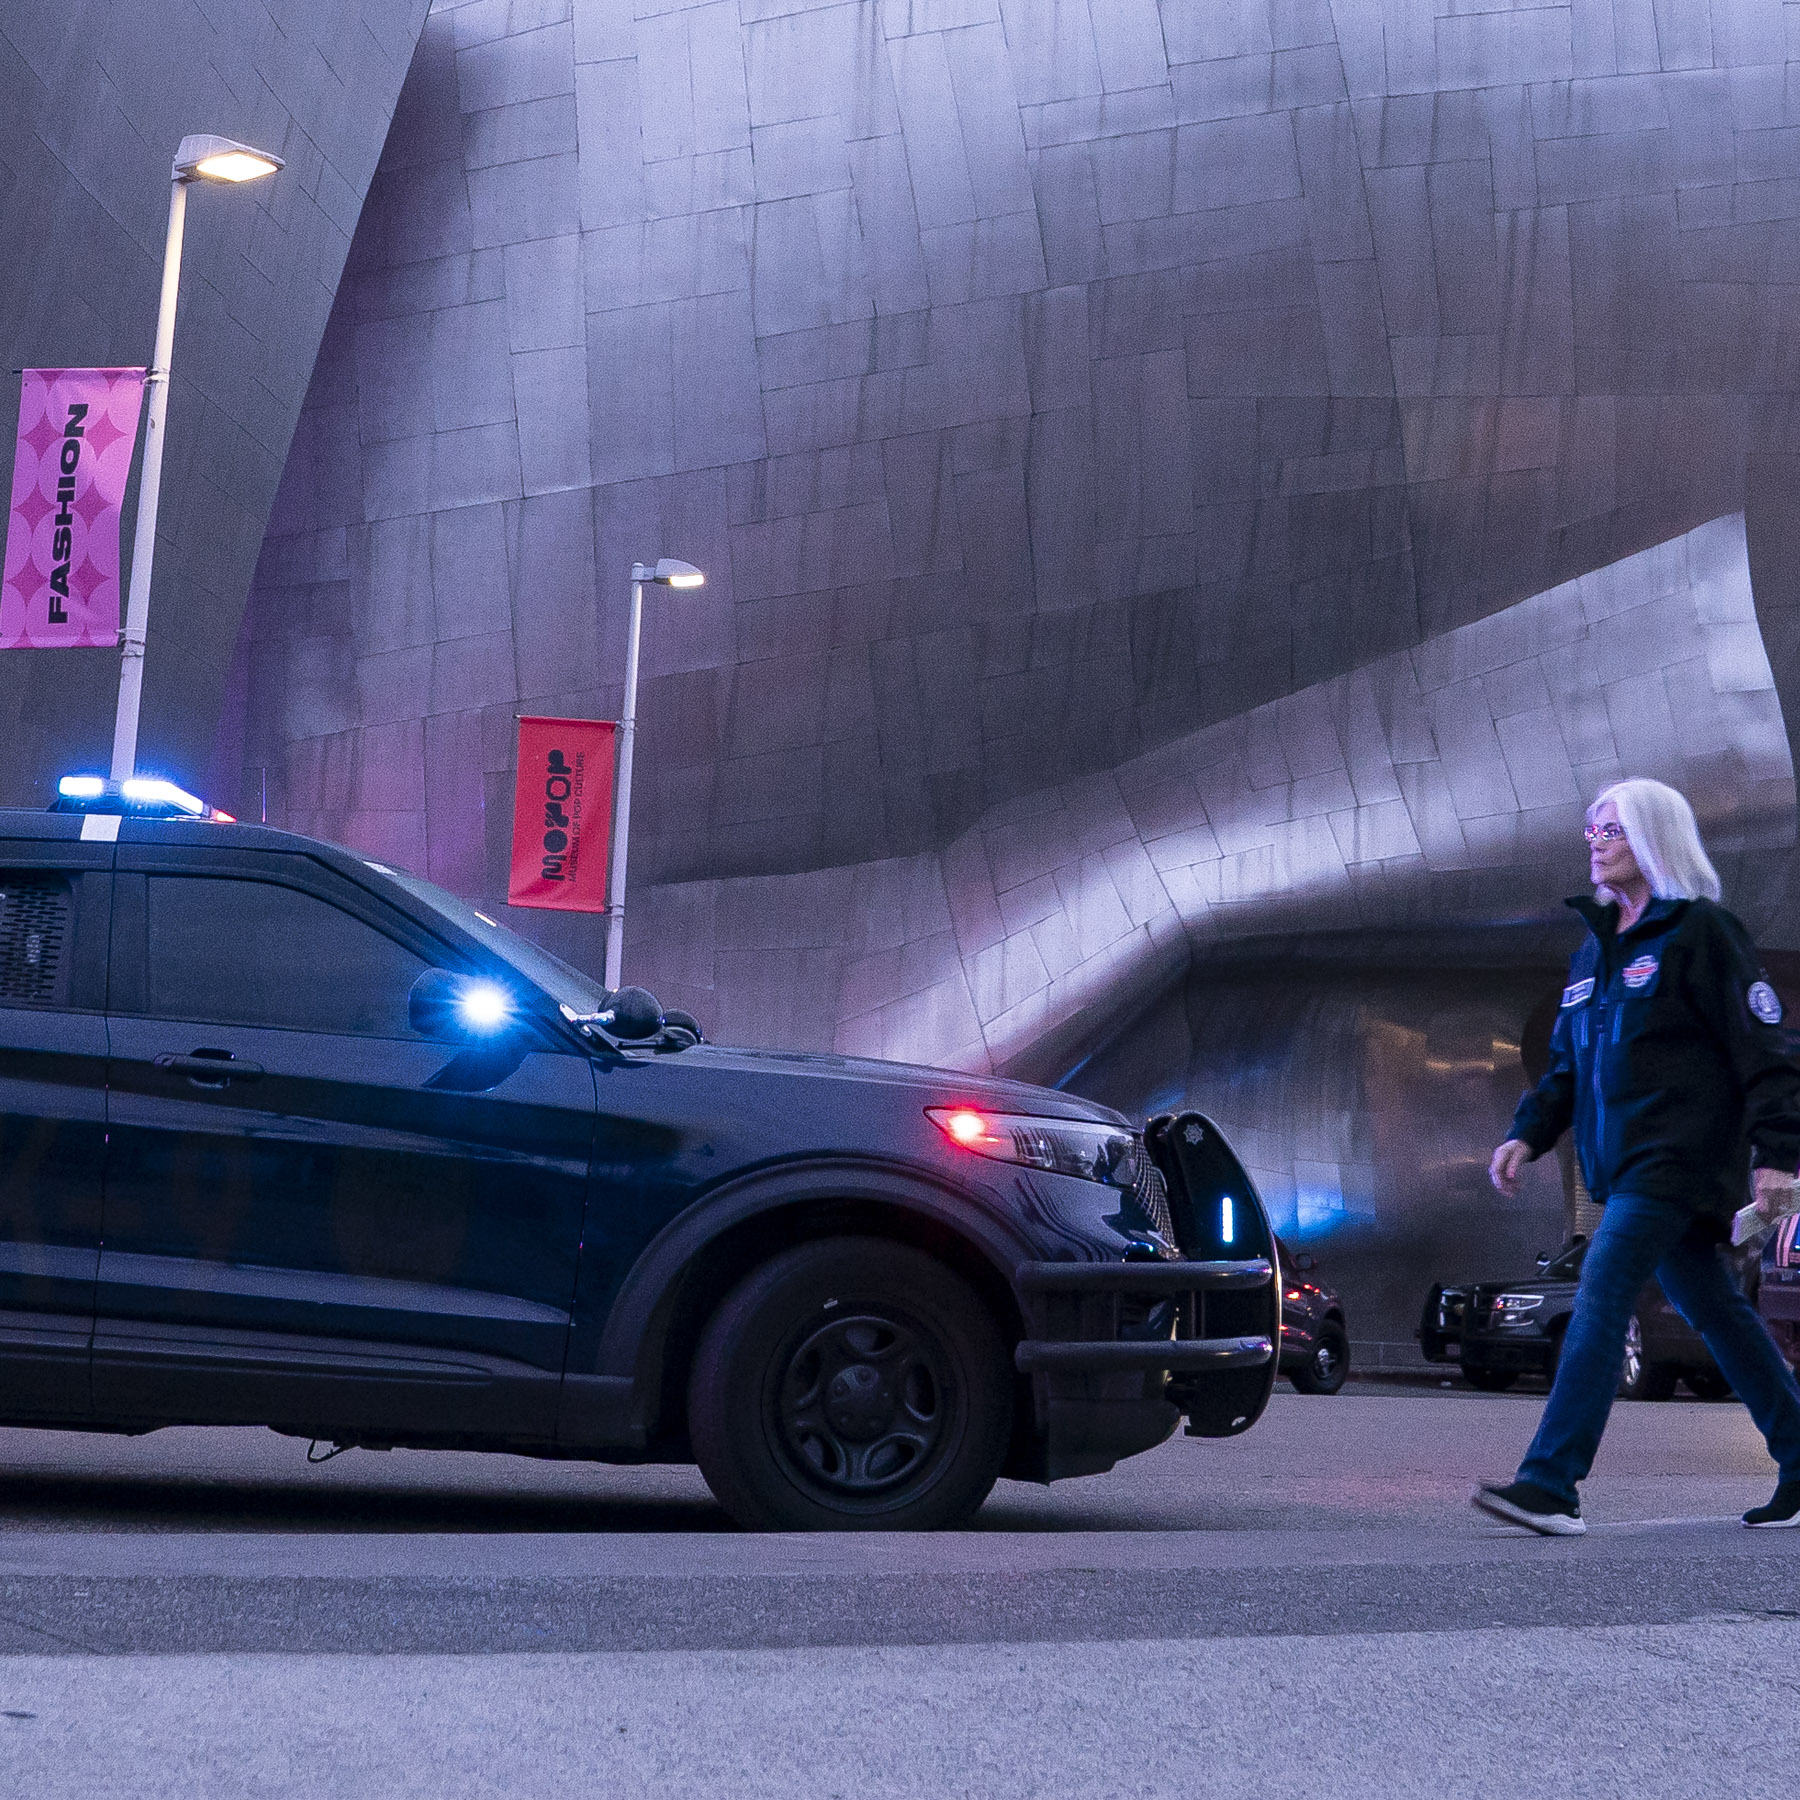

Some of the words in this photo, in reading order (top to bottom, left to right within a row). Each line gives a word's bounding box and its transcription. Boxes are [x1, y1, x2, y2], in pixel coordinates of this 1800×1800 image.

[48, 403, 89, 625] FASHION
[574, 751, 586, 798] CULTURE
[541, 749, 572, 882] MOPOP
[572, 800, 583, 820] POP
[572, 821, 581, 835] OF
[568, 835, 581, 883] MUSEUM
